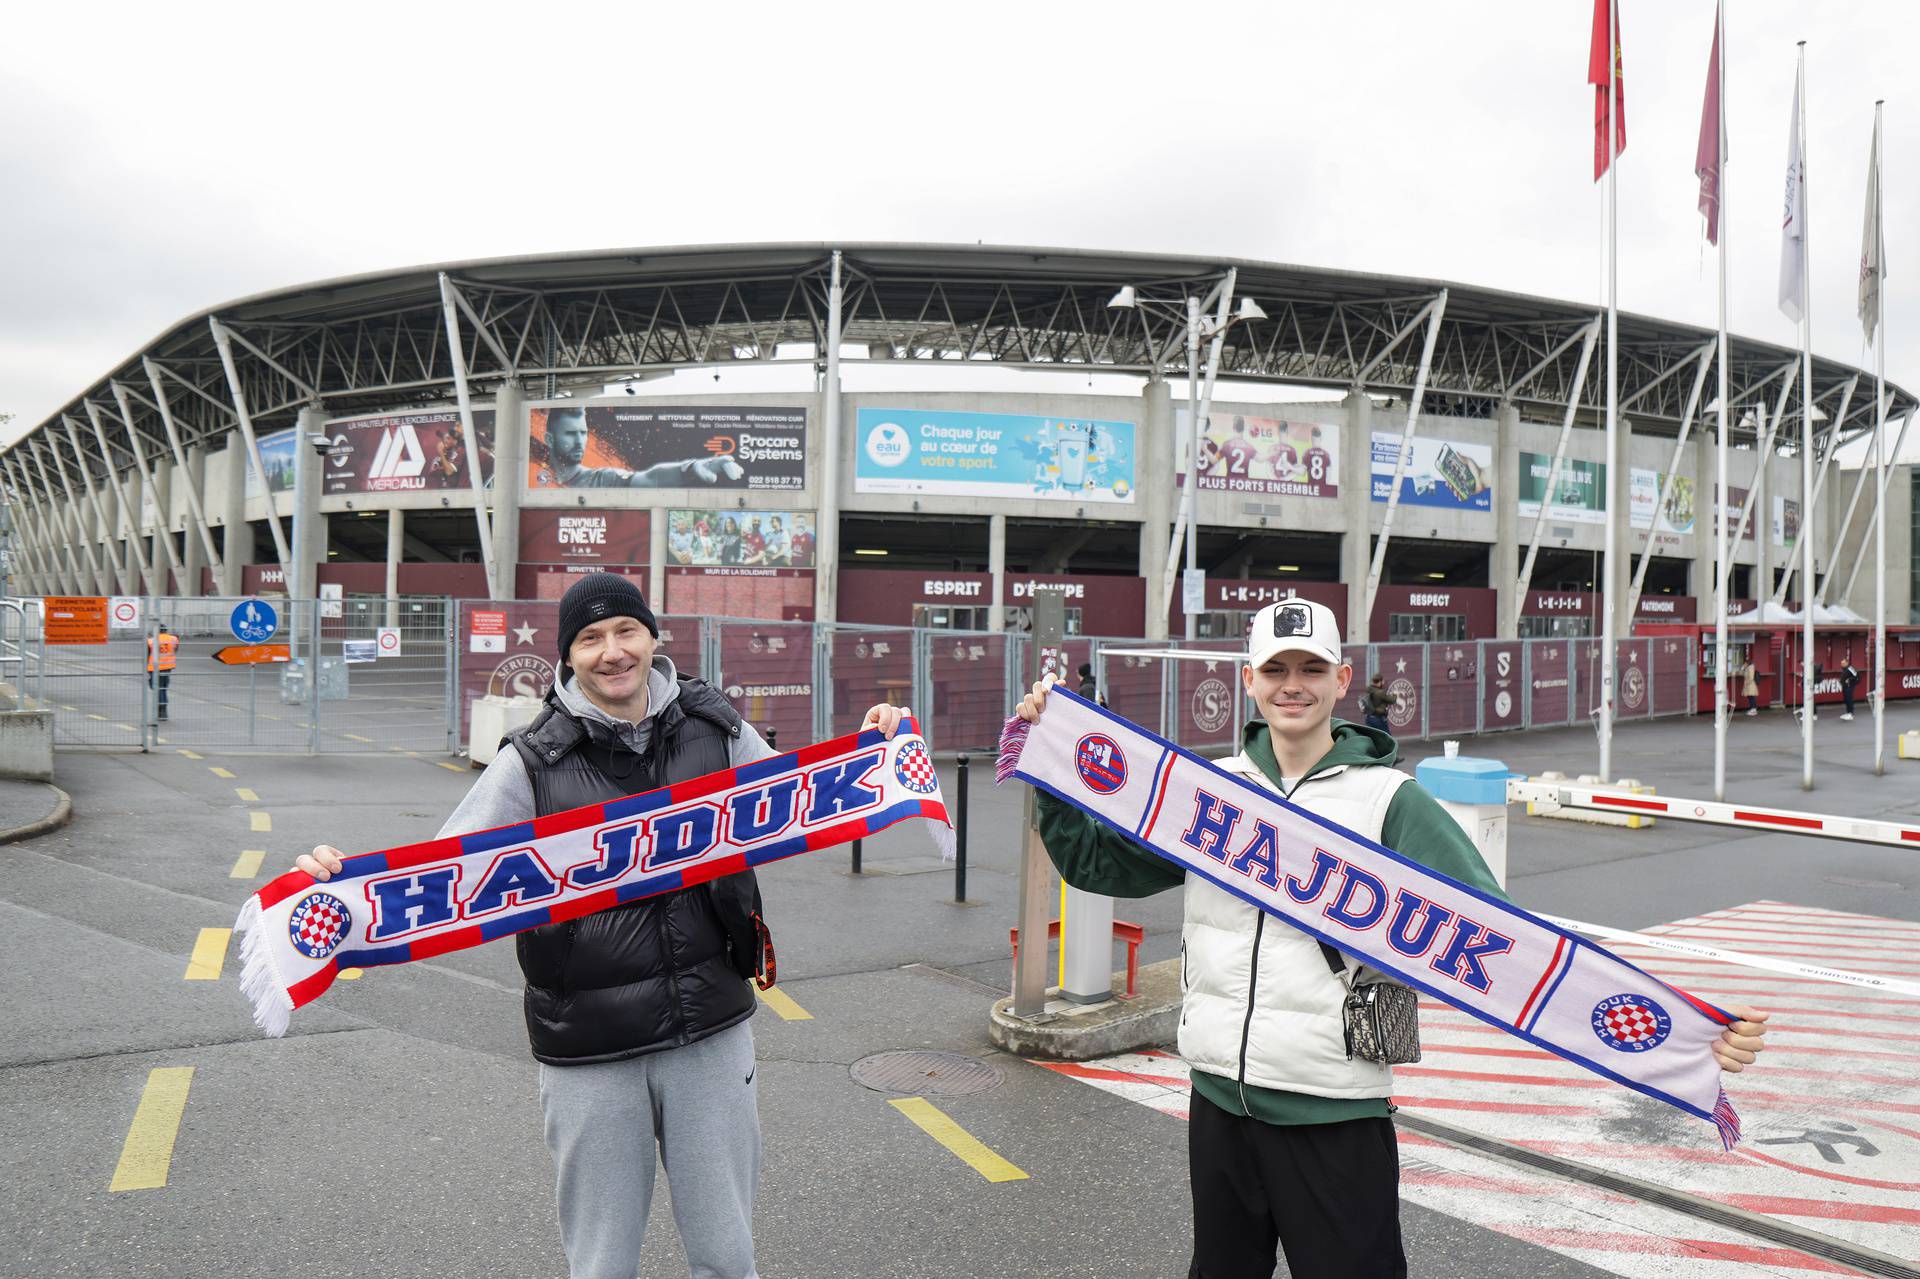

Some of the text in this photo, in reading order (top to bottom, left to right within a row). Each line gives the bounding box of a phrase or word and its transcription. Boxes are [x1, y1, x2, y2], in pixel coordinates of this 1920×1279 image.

[746, 414, 787, 422] RÉNOVATION
[739, 433, 800, 449] Procare
[920, 424, 1003, 442] Chaque jour
[1260, 428, 1273, 438] LG
[739, 447, 803, 463] Systems
[876, 443, 901, 452] eau
[920, 442, 998, 455] au cœur de
[920, 456, 998, 470] votre sport.
[1231, 448, 1246, 474] 2
[1275, 452, 1292, 476] 4
[1310, 455, 1324, 480] 8
[367, 477, 426, 491] MERCALU
[749, 476, 802, 485] 022 518 37 79
[1199, 476, 1320, 496] PLUS FORTS ENSEMBLE
[704, 568, 778, 577] MUR DE LA SOLIDARITÉ
[924, 580, 982, 596] ESPRIT
[1409, 593, 1450, 607] RESPECT
[1538, 596, 1582, 610] L-K-J-I-H
[497, 658, 553, 680] SERVETTE
[512, 671, 537, 699] S
[745, 684, 811, 697] SECURITAS
[1204, 692, 1219, 719] S
[904, 780, 936, 793] SPLIT
[367, 747, 886, 943] HAJDUK
[1180, 787, 1516, 994] HAJDUK
[290, 894, 343, 926] HAJDUK
[309, 932, 343, 958] SPLIT
[1593, 995, 1635, 1038] HAJDUK
[1632, 1014, 1669, 1051] SPLIT
